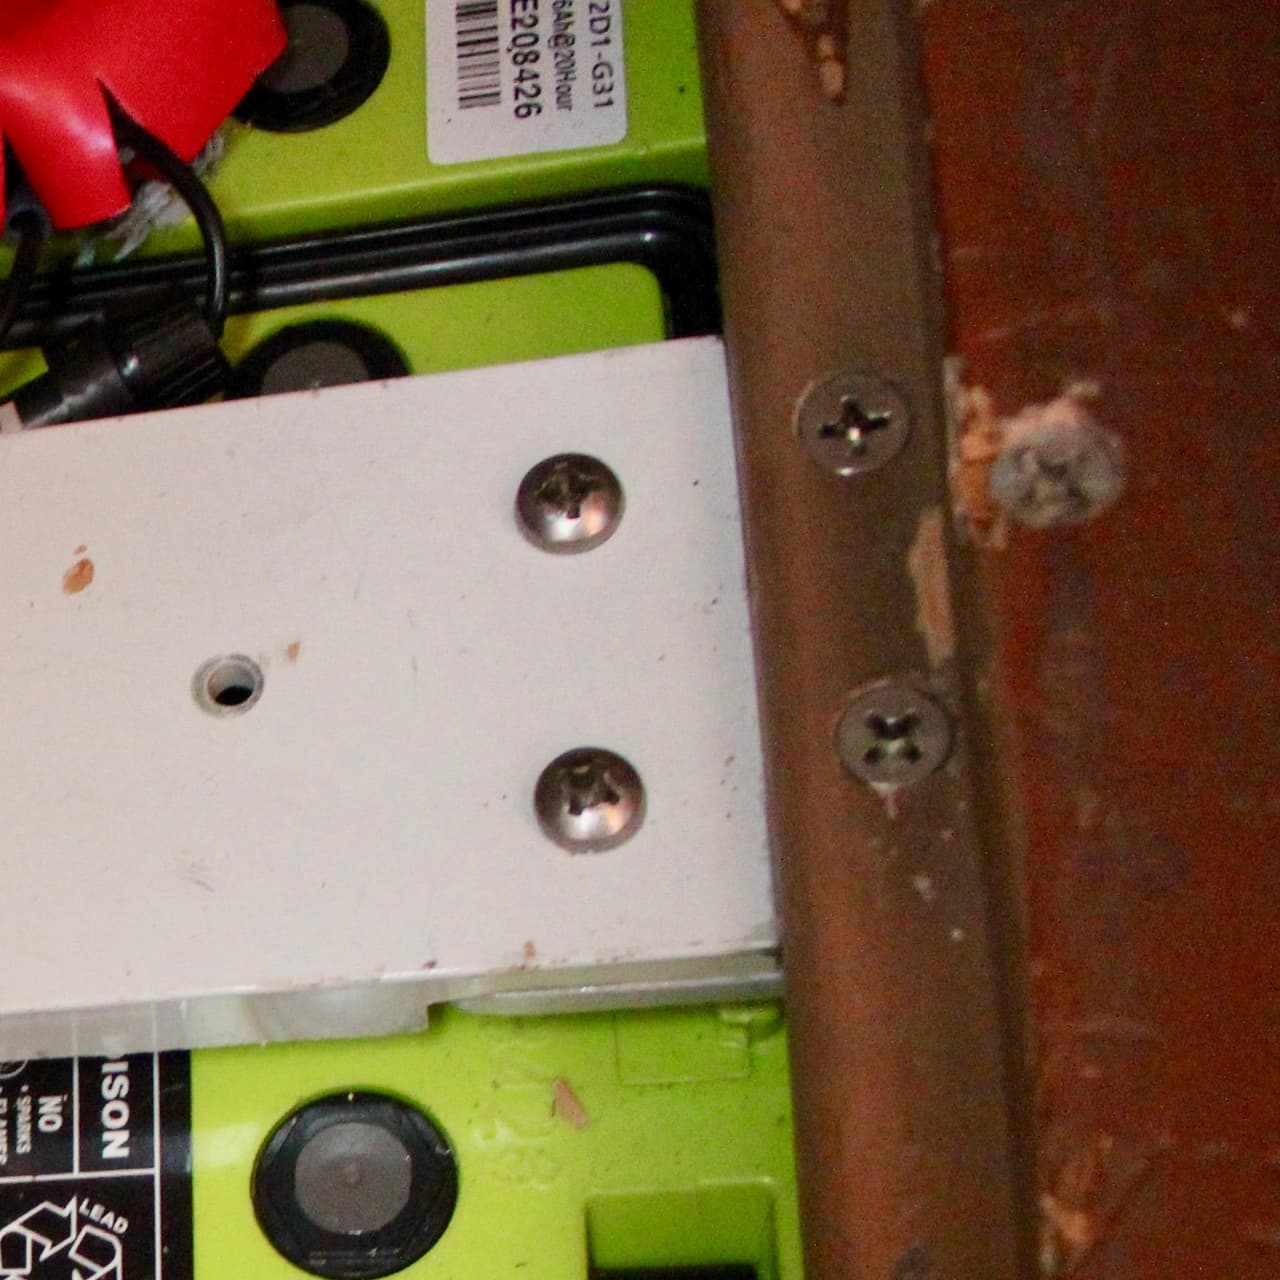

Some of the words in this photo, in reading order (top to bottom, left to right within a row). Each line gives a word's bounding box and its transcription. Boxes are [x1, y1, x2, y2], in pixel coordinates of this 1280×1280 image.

[15, 1097, 32, 1154] SPARKS
[37, 1095, 63, 1132] NO
[78, 1199, 127, 1233] LEAD
